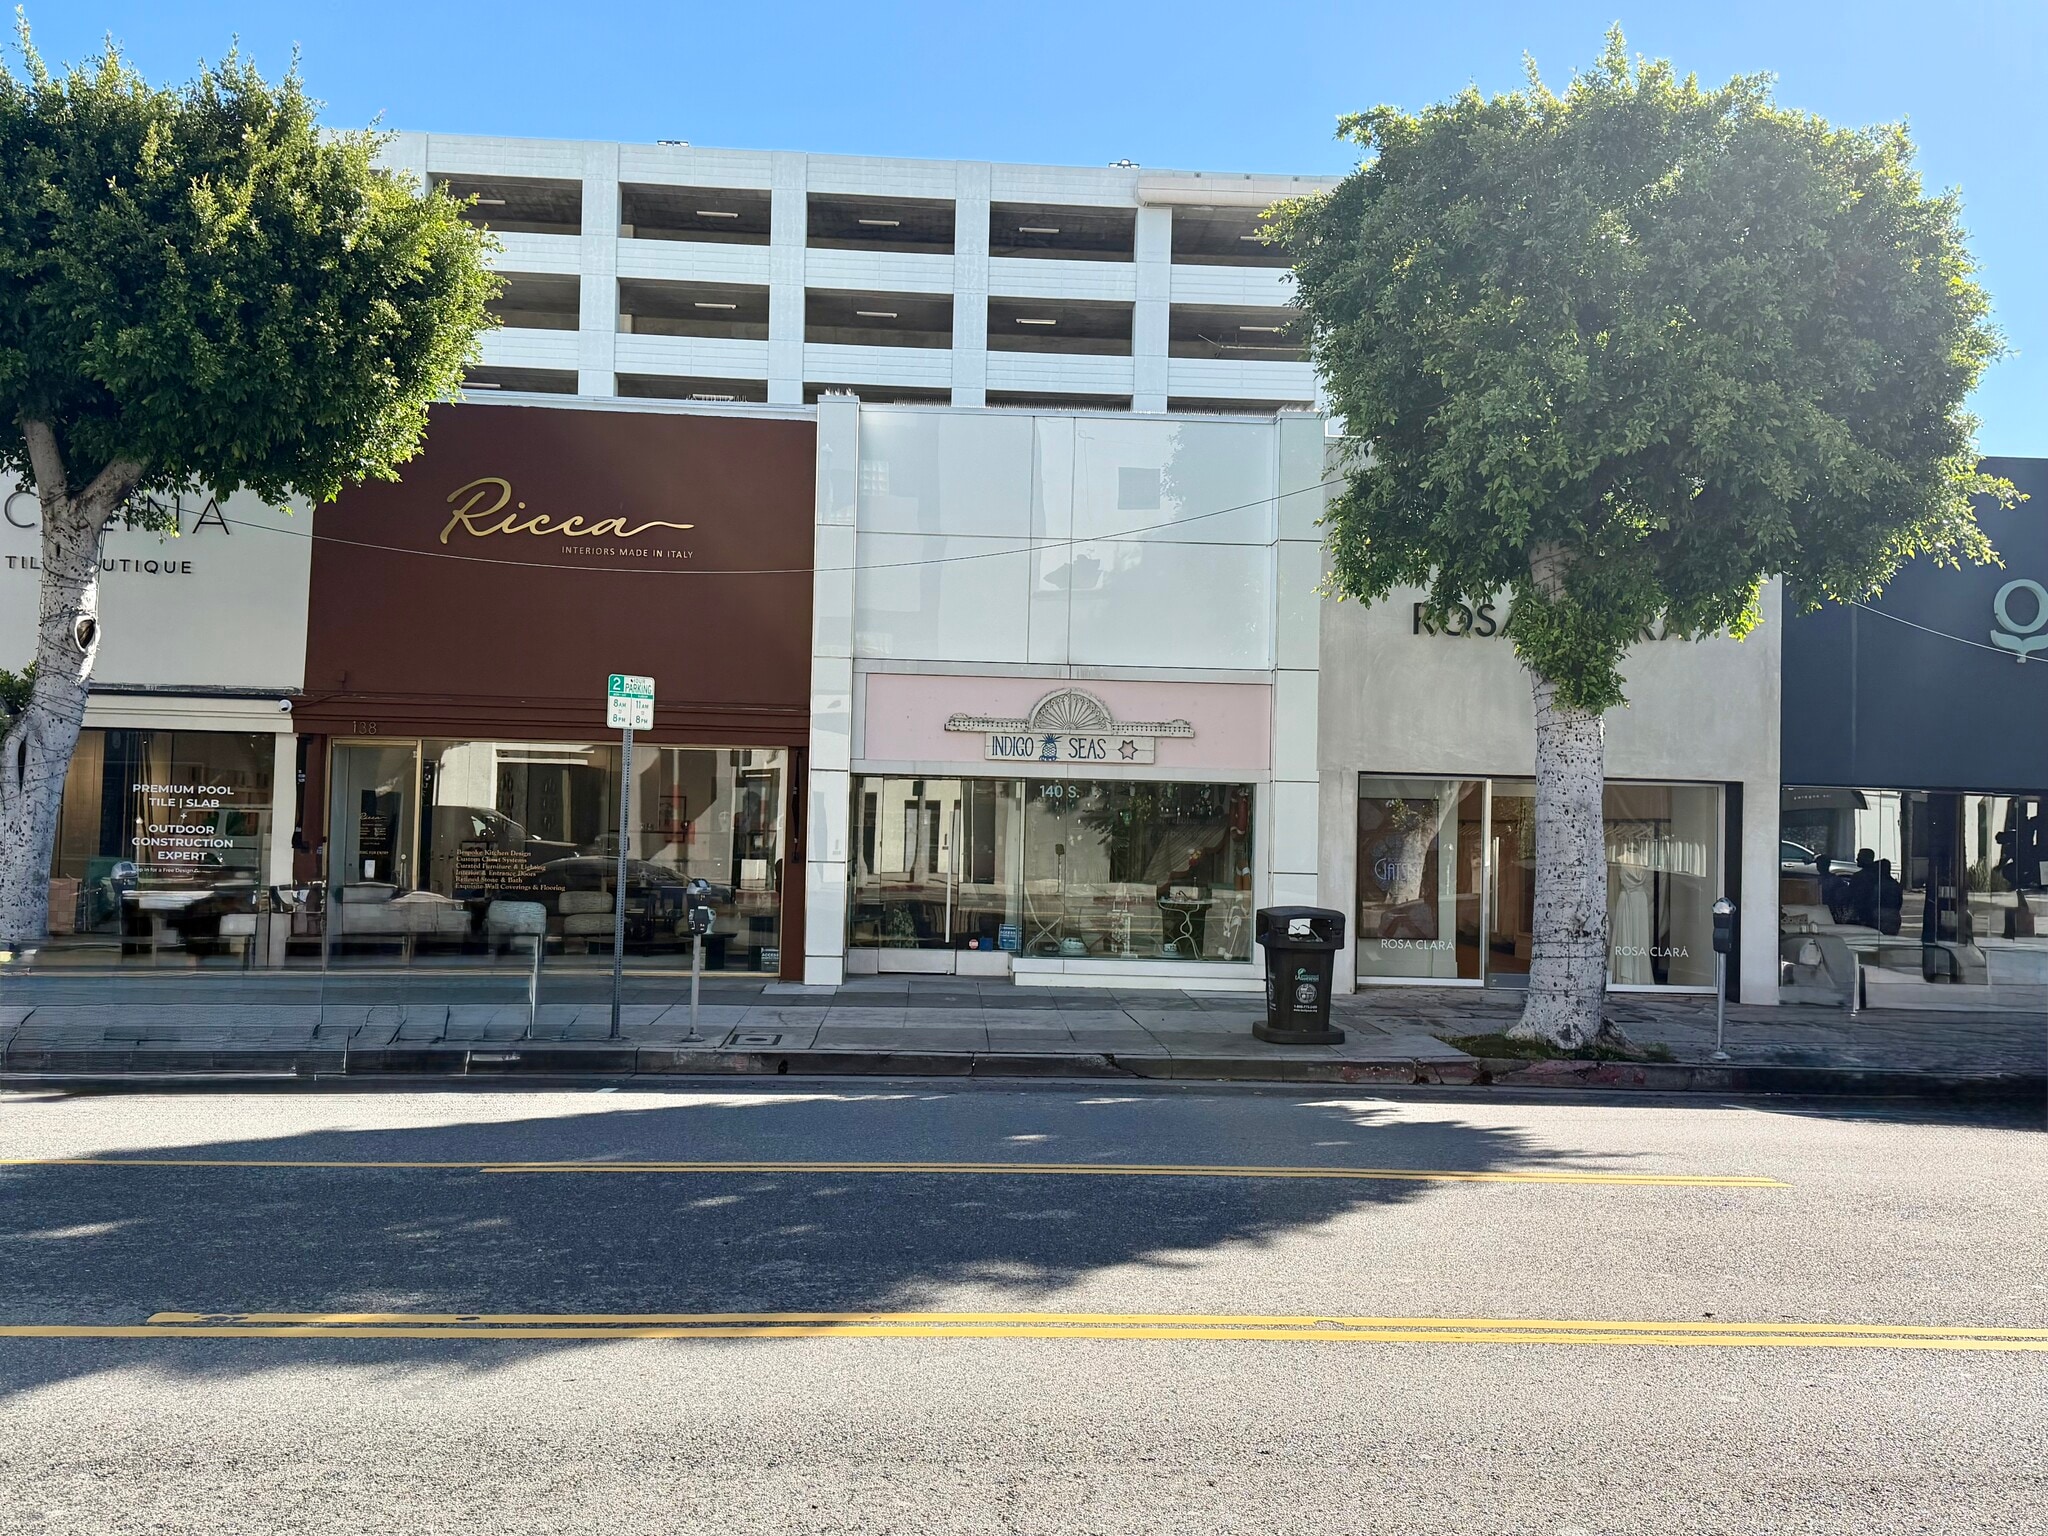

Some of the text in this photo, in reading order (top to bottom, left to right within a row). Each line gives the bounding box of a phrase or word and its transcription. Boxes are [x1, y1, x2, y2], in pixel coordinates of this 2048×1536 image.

[440, 477, 694, 544] Ricca
[561, 546, 615, 556] INTERIORS
[619, 548, 648, 557] MADE
[667, 550, 694, 558] ITALY
[5, 555, 192, 574] TIL UTIQUE
[612, 677, 621, 690] 2
[625, 682, 652, 694] PARKING
[353, 720, 376, 734] 138
[992, 736, 1106, 760] INDIGO SEAS
[132, 784, 234, 795] PREMIUM POOL
[1040, 785, 1080, 798] 140 S.
[149, 798, 176, 807] TILE
[186, 798, 220, 808] SLAB
[148, 824, 214, 834] OUTDOOR
[132, 837, 233, 848] CONSTRUCTION
[158, 851, 207, 861] EXPERT
[1381, 939, 1454, 950] ROSA CLARÁ
[1615, 946, 1689, 958] ROSA CLARÁ
